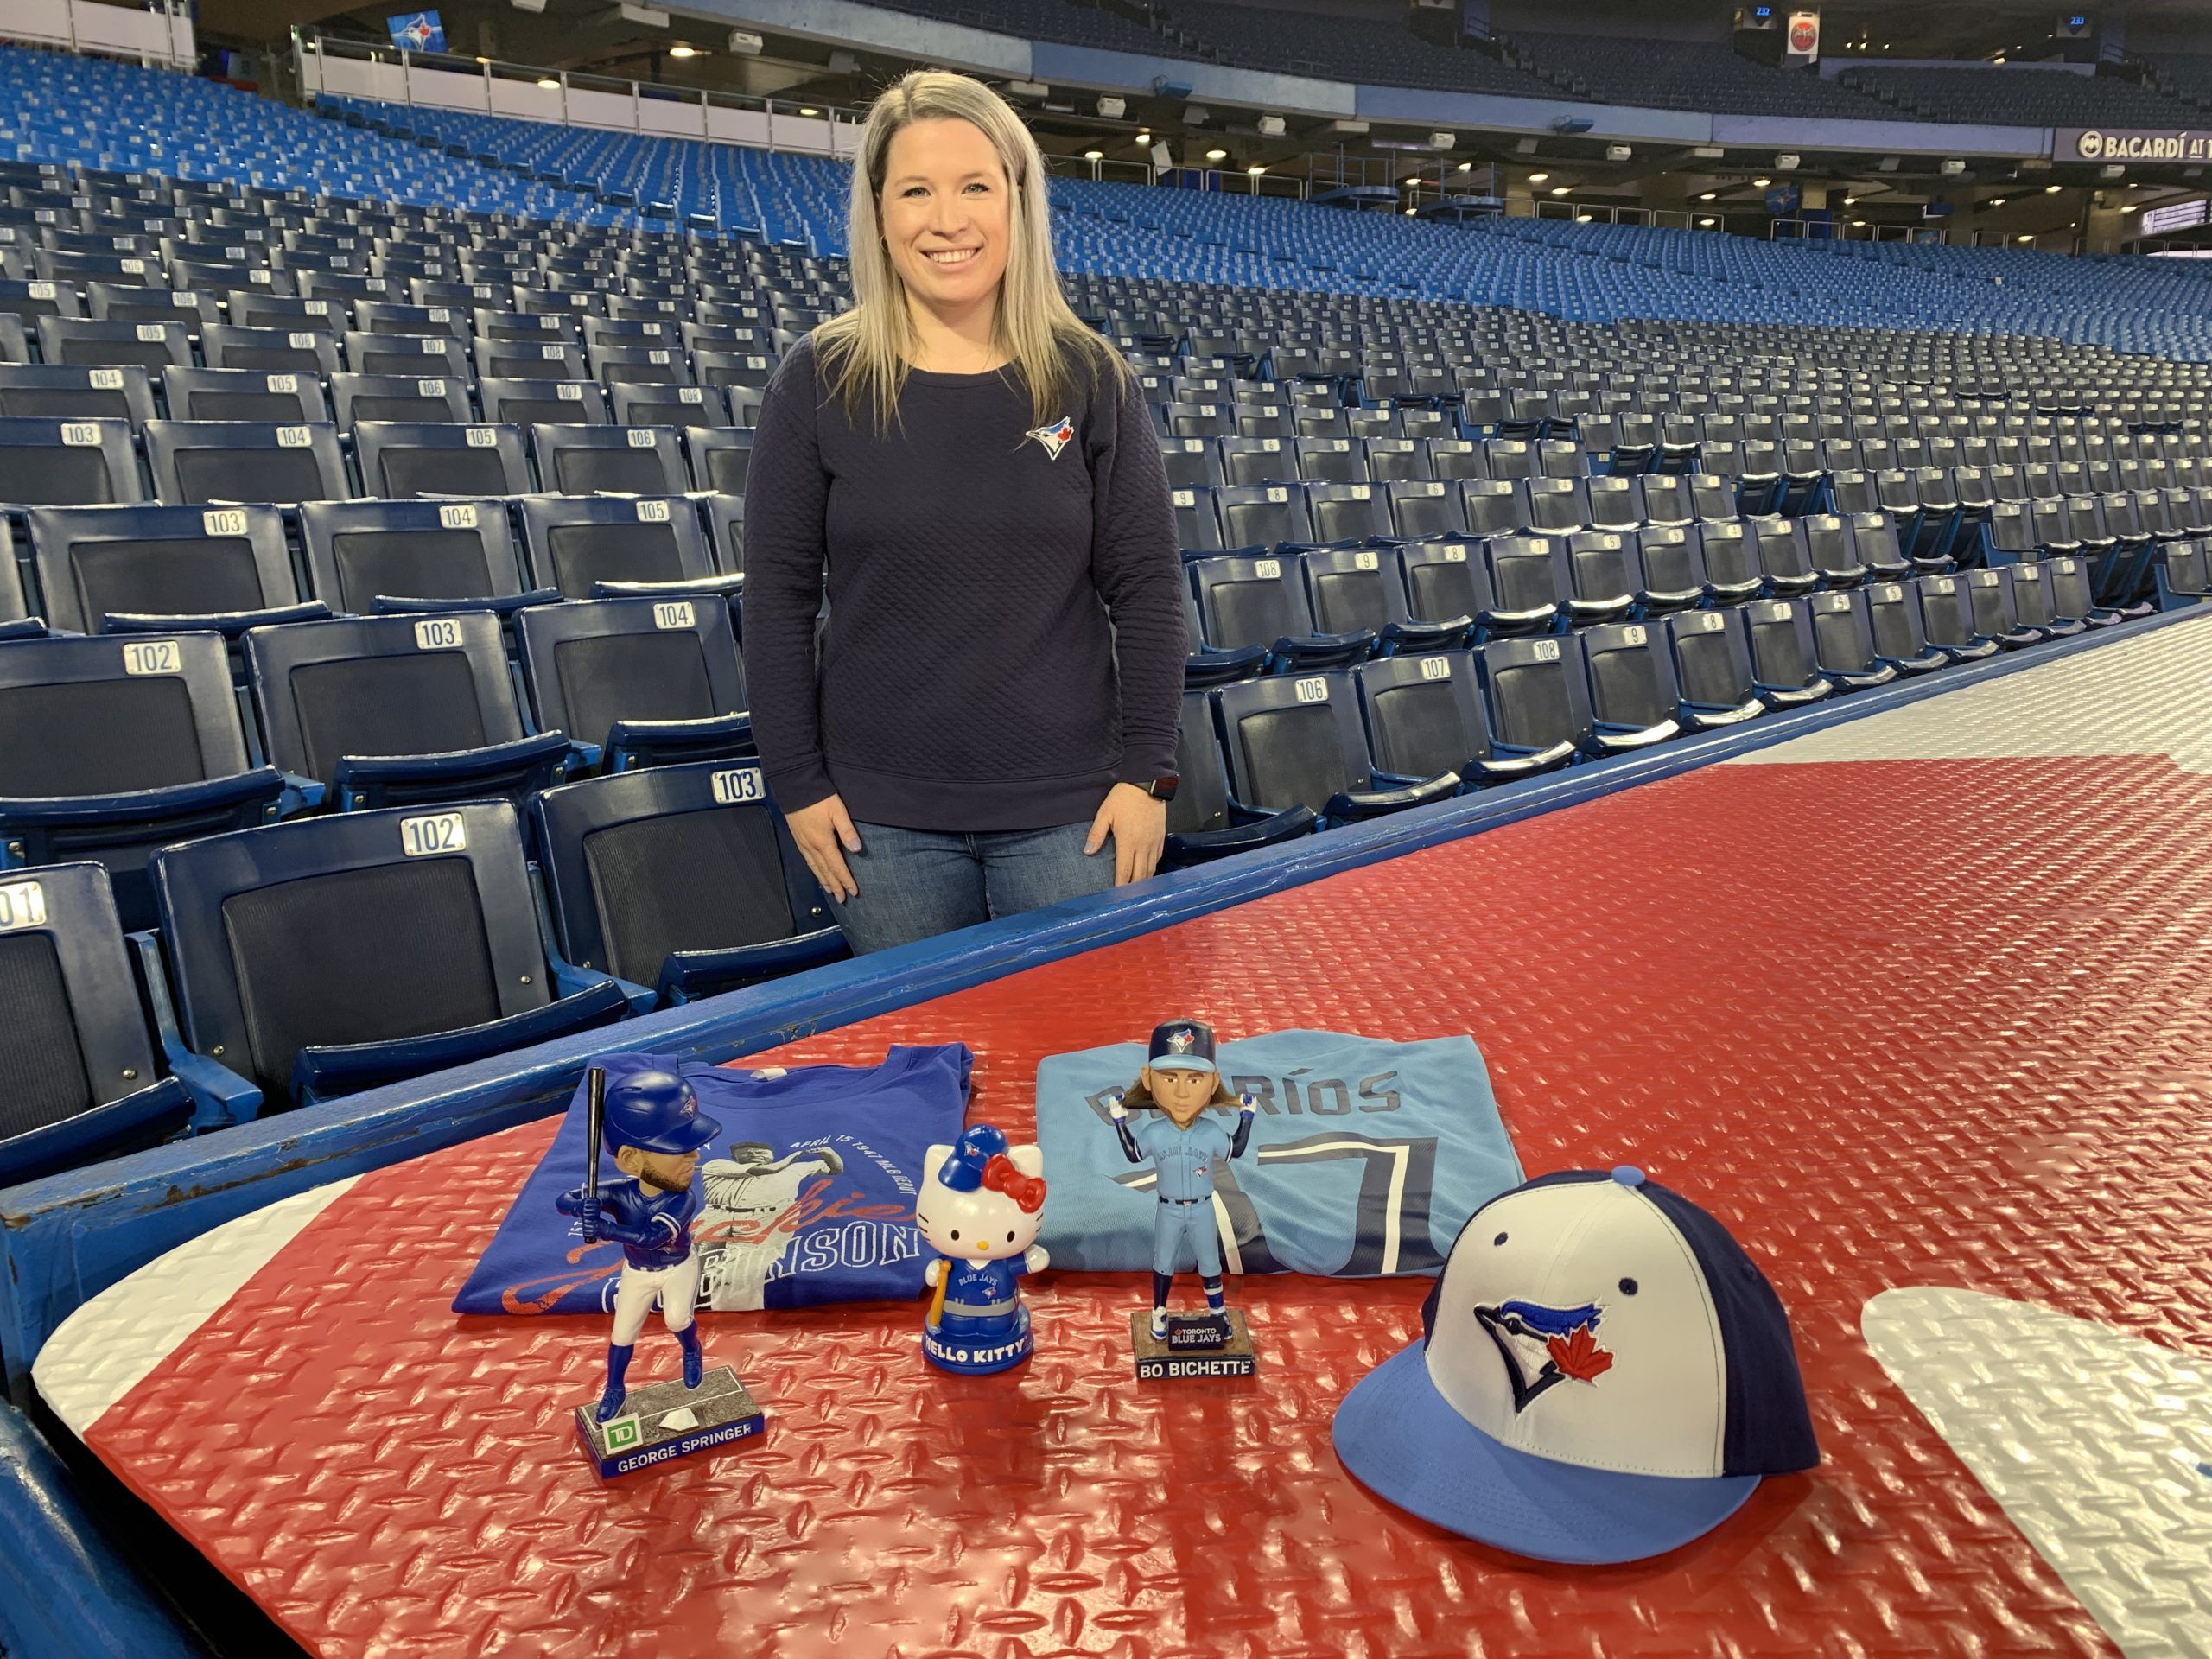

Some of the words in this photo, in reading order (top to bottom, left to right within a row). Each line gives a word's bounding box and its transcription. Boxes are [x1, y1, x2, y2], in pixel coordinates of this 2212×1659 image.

[2104, 131, 2188, 159] BACARDÍ
[2190, 138, 2205, 159] AT
[142, 326, 161, 340] 105
[296, 334, 311, 346] 106
[426, 340, 442, 353] 107
[546, 346, 561, 358] 108
[655, 352, 664, 363] 10
[95, 372, 118, 387] 104
[271, 378, 293, 391] 105
[423, 381, 442, 395] 106
[563, 385, 578, 398] 107
[683, 389, 698, 402] 108
[67, 426, 94, 444] 103
[282, 428, 307, 445] 104
[471, 430, 492, 446] 105
[631, 431, 652, 447] 106
[1179, 492, 1186, 505] 9
[1274, 488, 1281, 501] 8
[1358, 486, 1365, 499] 7
[446, 507, 472, 526] 104
[641, 502, 664, 520] 105
[209, 512, 241, 533] 103
[1536, 541, 1543, 553] 7
[1609, 537, 1616, 548] 6
[1363, 554, 1370, 568] 9
[1452, 547, 1459, 560] 8
[1258, 561, 1278, 577] 108
[658, 605, 690, 626] 104
[1778, 605, 1785, 618] 7
[1710, 614, 1717, 629] 8
[422, 622, 455, 647] 103
[1632, 627, 1639, 643] 9
[132, 644, 171, 672] 102
[1536, 642, 1556, 660] 108
[1424, 659, 1446, 678] 107
[1299, 679, 1324, 700] 106
[717, 771, 757, 801] 103
[410, 818, 454, 853] 102
[0, 887, 35, 926] 01
[1084, 1067, 1403, 1126] BRÍOS
[790, 1135, 832, 1148] APRIL
[835, 1134, 855, 1142] 15
[852, 1141, 883, 1158] 1947
[875, 1160, 902, 1174] MLB
[501, 1179, 918, 1318] Jckie
[601, 1220, 923, 1315] BINSON
[958, 1274, 978, 1287] BLUE
[979, 1274, 998, 1287] JAYS
[1172, 1334, 1196, 1344] BLUE
[1198, 1333, 1222, 1344] JAYS
[925, 1334, 968, 1363] HELLO
[973, 1338, 1025, 1363] KITTY
[1140, 1363, 1164, 1378] BO
[1168, 1360, 1251, 1377] BICHETTE
[610, 1425, 634, 1443] TD
[618, 1445, 677, 1473] GEORGE
[681, 1422, 753, 1454] SPRINGER
